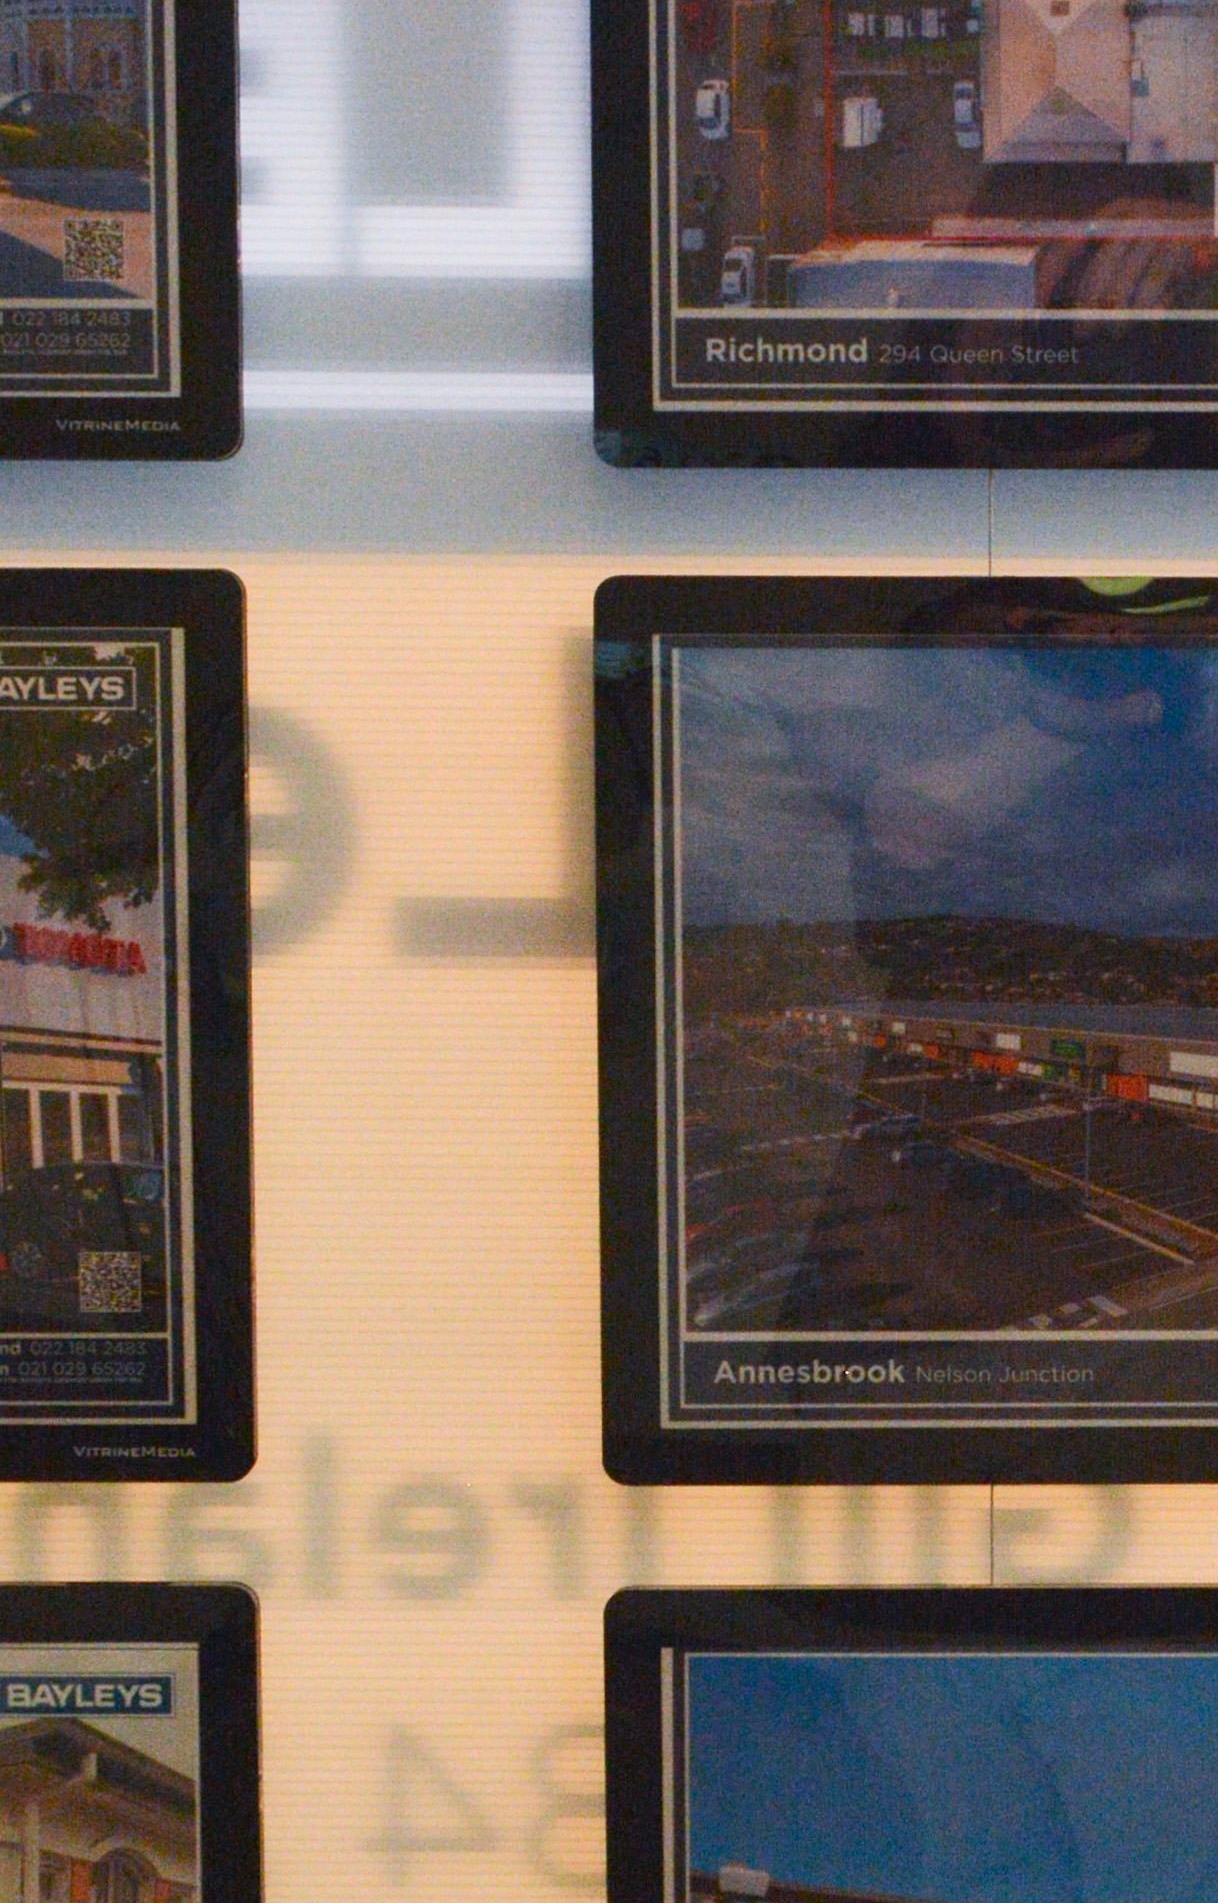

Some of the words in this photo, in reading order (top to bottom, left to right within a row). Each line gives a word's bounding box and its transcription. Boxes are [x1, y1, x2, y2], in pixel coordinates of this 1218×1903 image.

[36, 332, 70, 348] 029
[75, 332, 130, 348] 65262
[705, 337, 869, 363] Richmond
[879, 345, 921, 364] 294
[930, 345, 1003, 365] Queen
[1011, 345, 1079, 364] Street
[18, 1362, 47, 1376] 021
[53, 1362, 86, 1376] 029
[91, 1362, 145, 1376] 65262
[714, 1359, 904, 1384] Annesbrook
[915, 1365, 991, 1383] Nelson
[999, 1365, 1093, 1383] Junction
[7, 1683, 163, 1707] BAYLEYS
